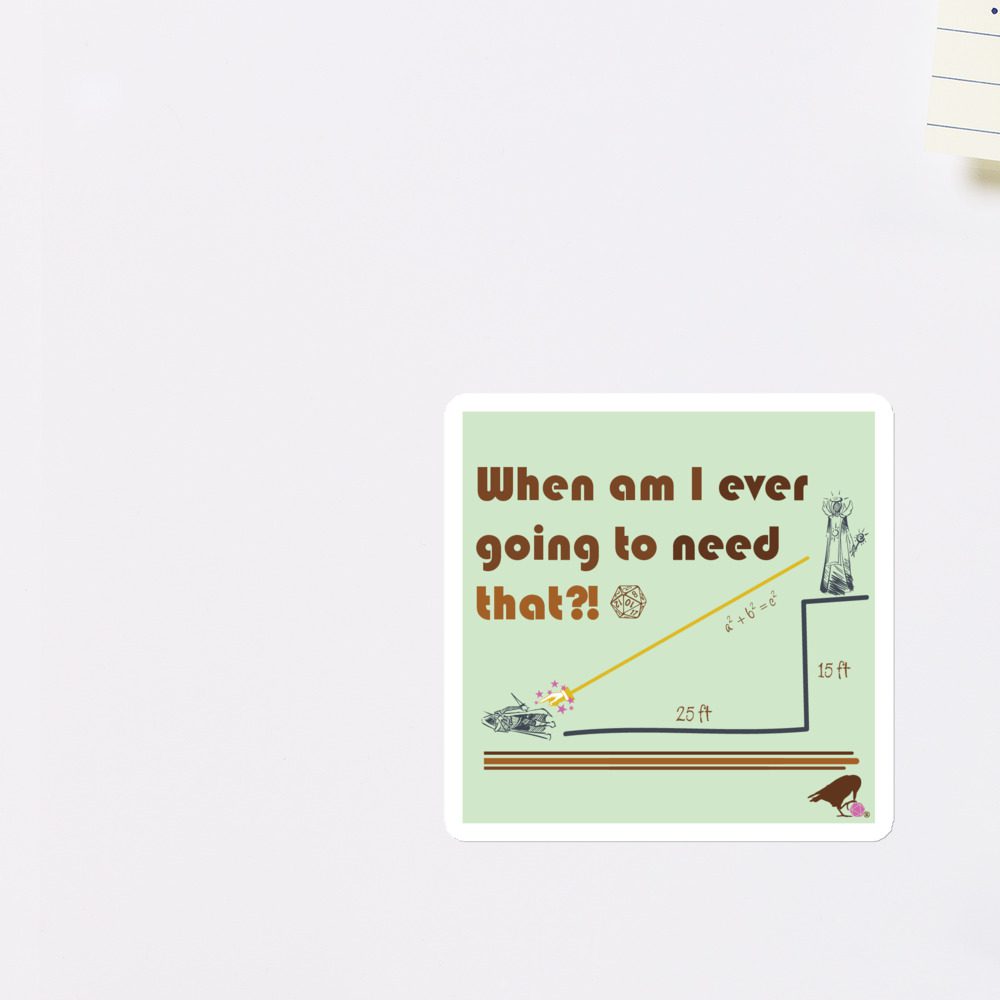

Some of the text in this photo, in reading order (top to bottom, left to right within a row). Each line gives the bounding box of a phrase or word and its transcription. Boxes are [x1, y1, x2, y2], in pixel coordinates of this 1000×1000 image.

[476, 466, 809, 502] When am I ever
[475, 523, 780, 573] going to need
[476, 584, 600, 621] that?!
[817, 660, 851, 681] 15 ft
[675, 704, 713, 723] 25 ft
